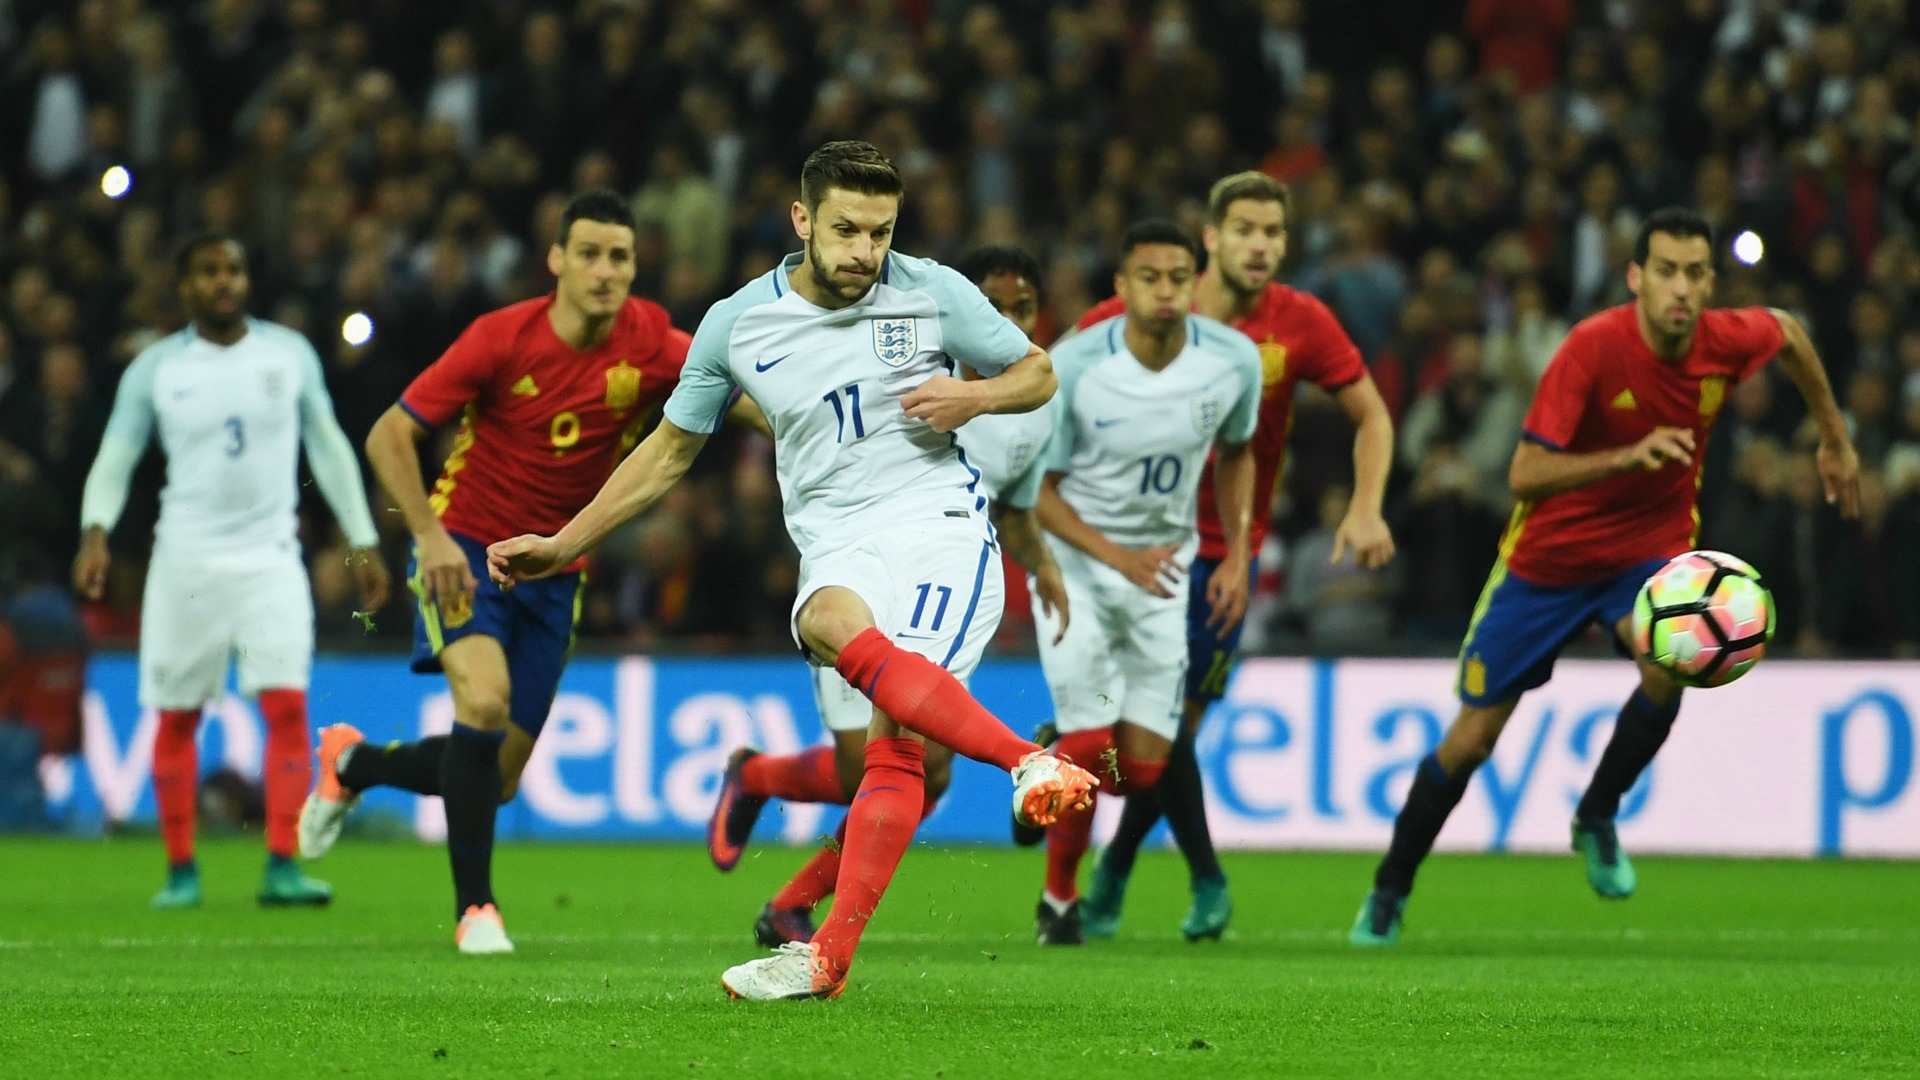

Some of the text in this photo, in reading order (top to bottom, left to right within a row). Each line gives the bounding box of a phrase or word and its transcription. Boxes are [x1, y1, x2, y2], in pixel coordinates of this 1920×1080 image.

[224, 415, 245, 459] 3
[822, 383, 865, 444] 11
[1137, 454, 1182, 496] 10
[909, 582, 953, 632] 11
